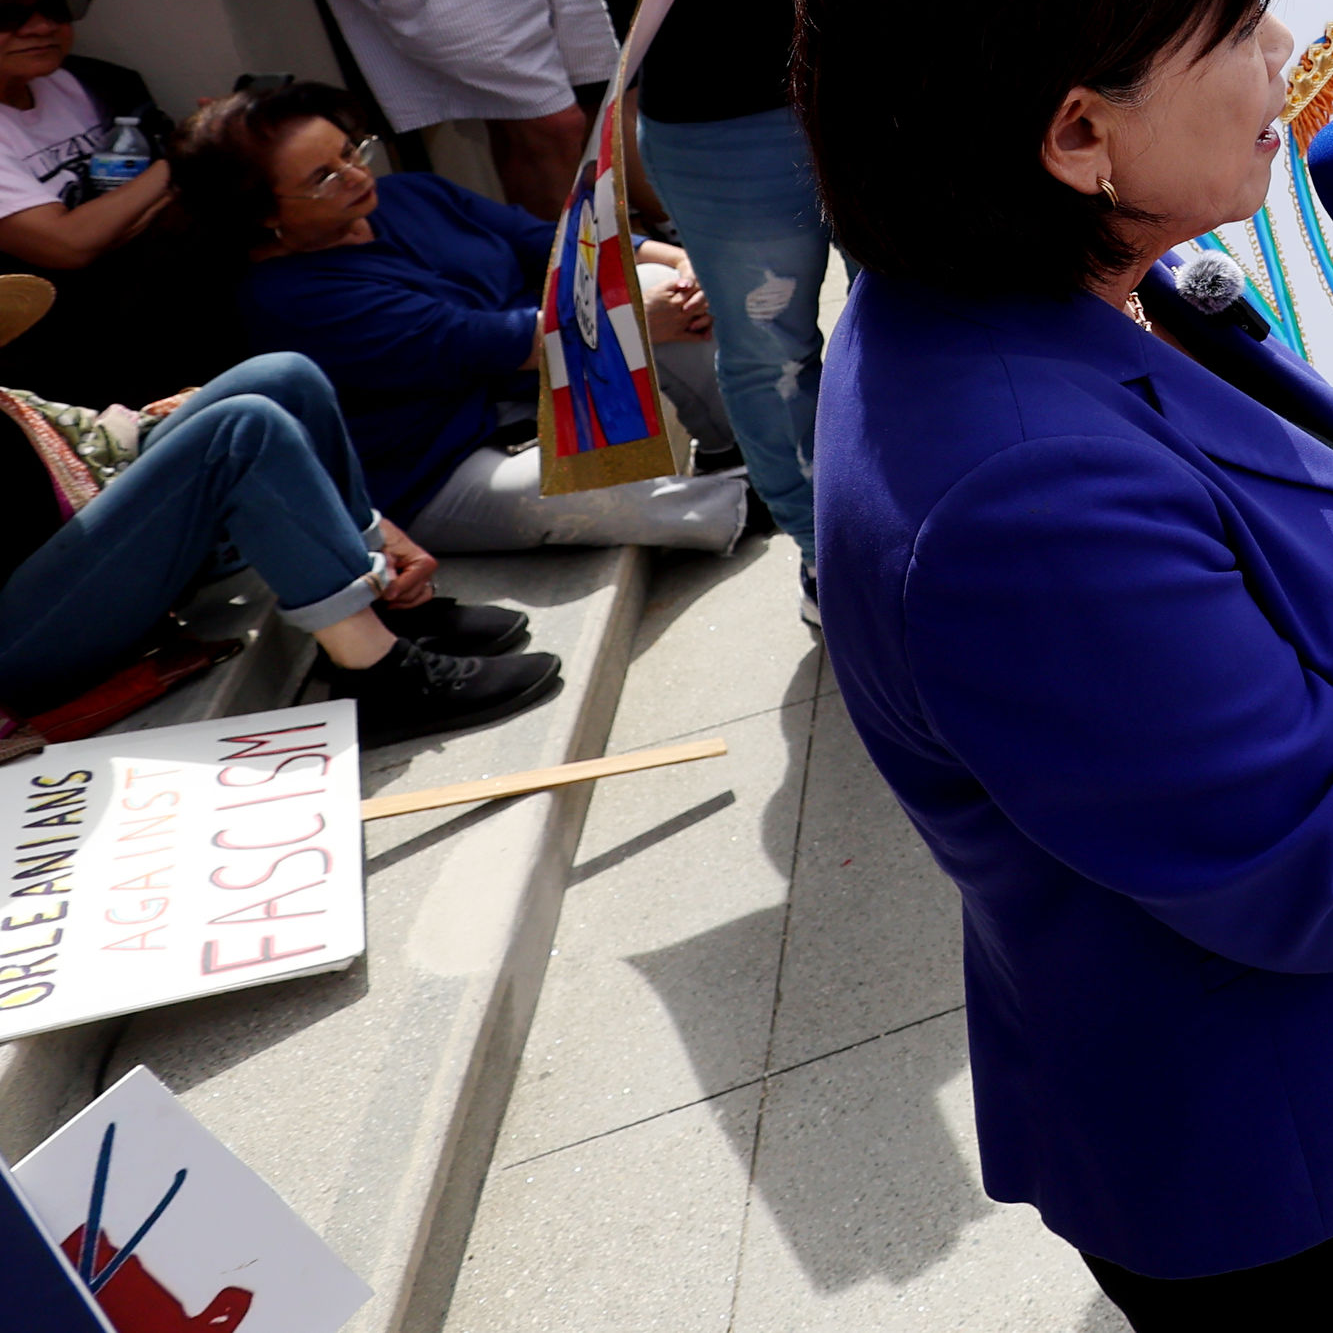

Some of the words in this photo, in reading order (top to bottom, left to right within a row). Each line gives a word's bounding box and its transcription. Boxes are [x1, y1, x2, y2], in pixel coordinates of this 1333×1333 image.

[0, 768, 97, 1012] ORLEANIANS
[100, 763, 183, 957] AGAINST
[199, 720, 334, 978] FASCISM
